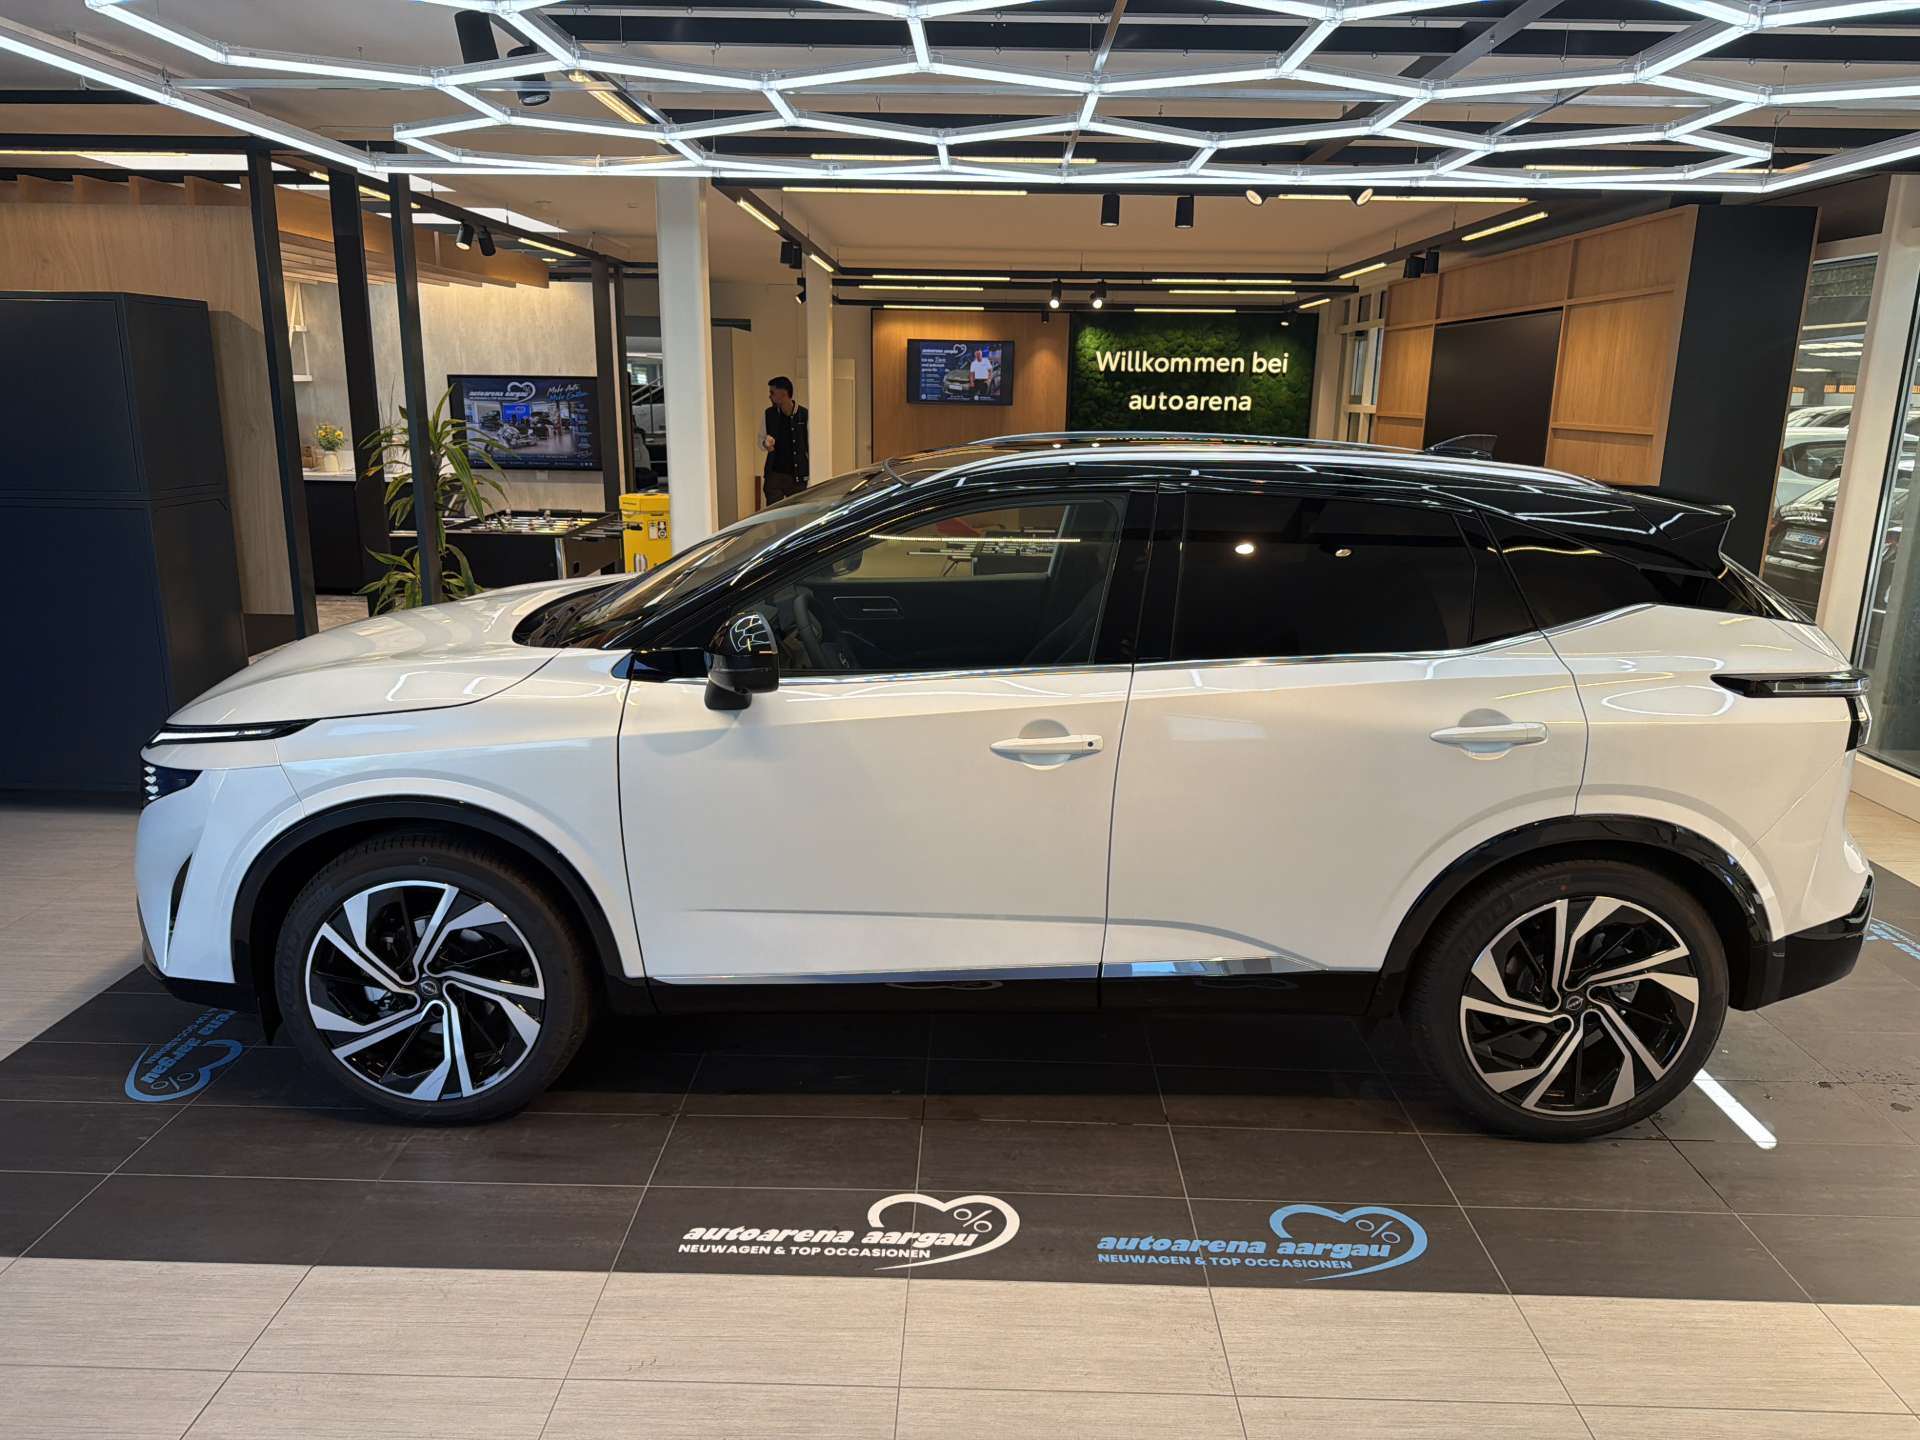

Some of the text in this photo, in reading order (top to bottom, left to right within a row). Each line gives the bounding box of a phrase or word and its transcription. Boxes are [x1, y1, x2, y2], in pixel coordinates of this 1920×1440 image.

[1096, 350, 1290, 374] Willkommen bei
[1128, 391, 1253, 412] autoarena
[682, 1225, 979, 1249] autoarena aargau
[1096, 1235, 1392, 1259] autoarena aargau
[678, 1244, 931, 1259] NEUWAGEN & TOP OCCASIONEN
[1098, 1253, 1353, 1270] NEUWAGEN & TOP OCCASIONEN
